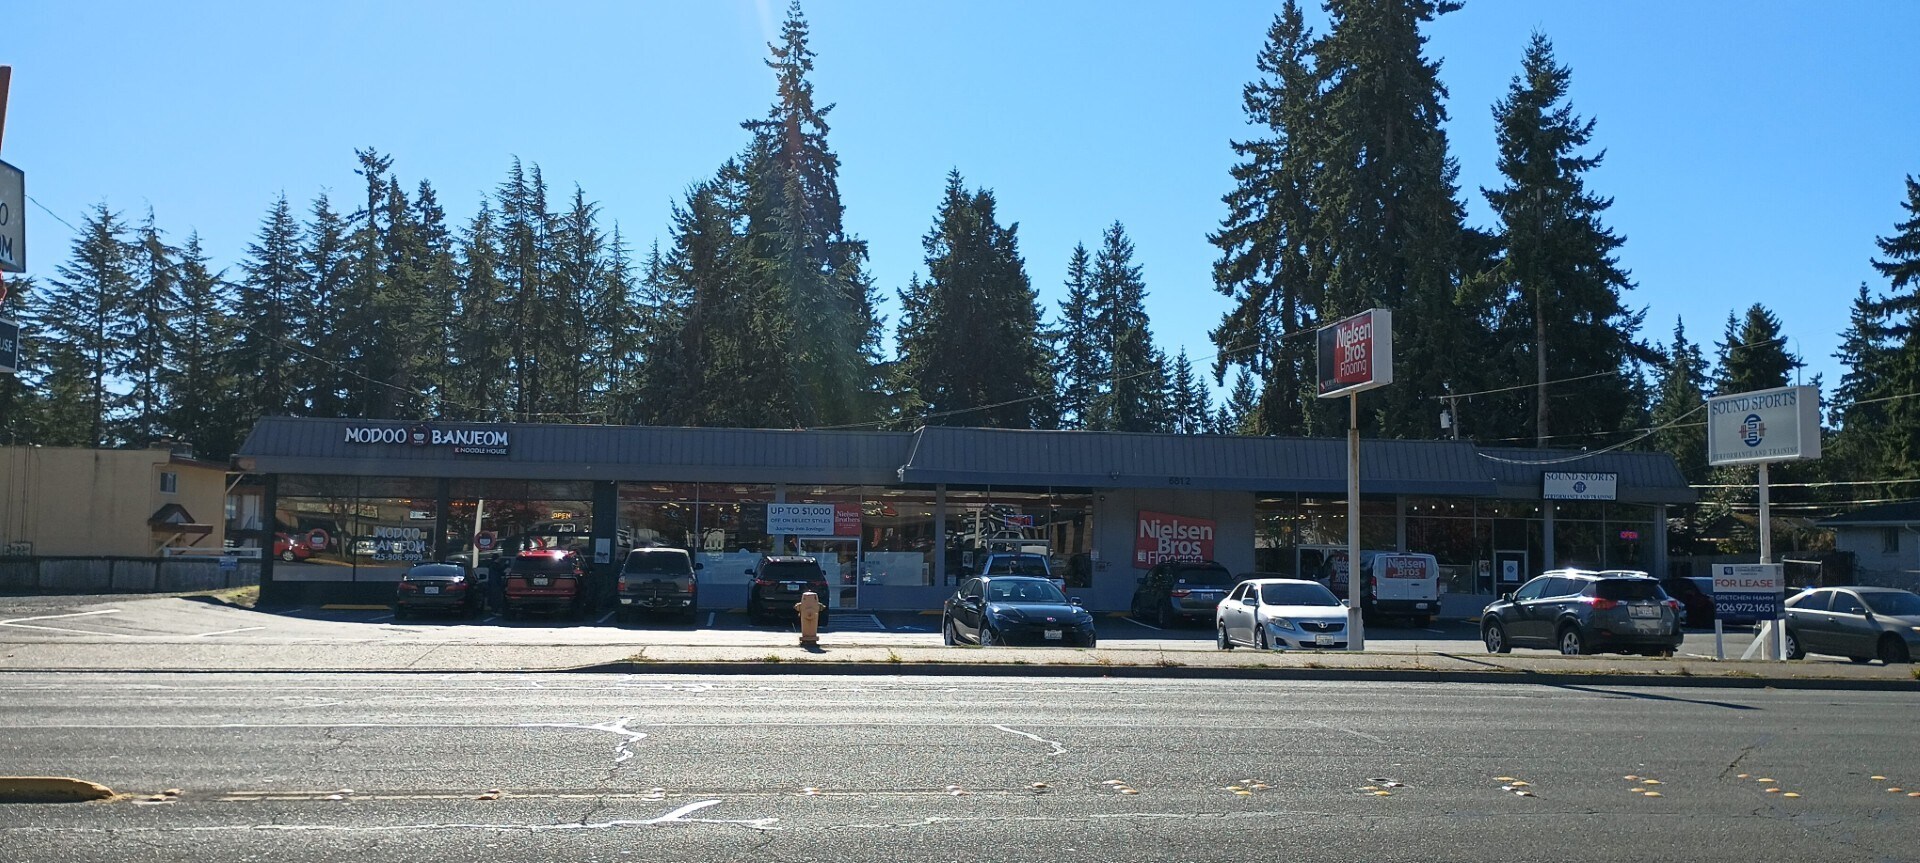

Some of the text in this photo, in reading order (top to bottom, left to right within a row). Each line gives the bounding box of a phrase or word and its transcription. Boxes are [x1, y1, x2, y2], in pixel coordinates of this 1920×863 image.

[1337, 322, 1371, 349] Nielsen
[1344, 342, 1366, 363] Bros
[1340, 359, 1367, 377] Flooring
[1712, 391, 1796, 415] SOUND SPORTS
[344, 428, 509, 446] MODOO BANJEOM
[1713, 450, 1752, 460] PERFORMANCE
[1769, 447, 1798, 455] TRAINING
[1545, 472, 1615, 481] SOUND SPORTS
[552, 511, 571, 519] OPEN
[770, 507, 831, 516] UP TO $1,000
[374, 527, 421, 539] MODOO
[1140, 519, 1213, 540] Nielsen
[1620, 531, 1638, 539] OPEN
[1158, 537, 1202, 555] Bros
[1387, 557, 1426, 569] Nielsen
[1397, 568, 1420, 576] Bros
[1714, 578, 1774, 588] FOR LEASE
[1716, 603, 1775, 612] 206.972.1651
